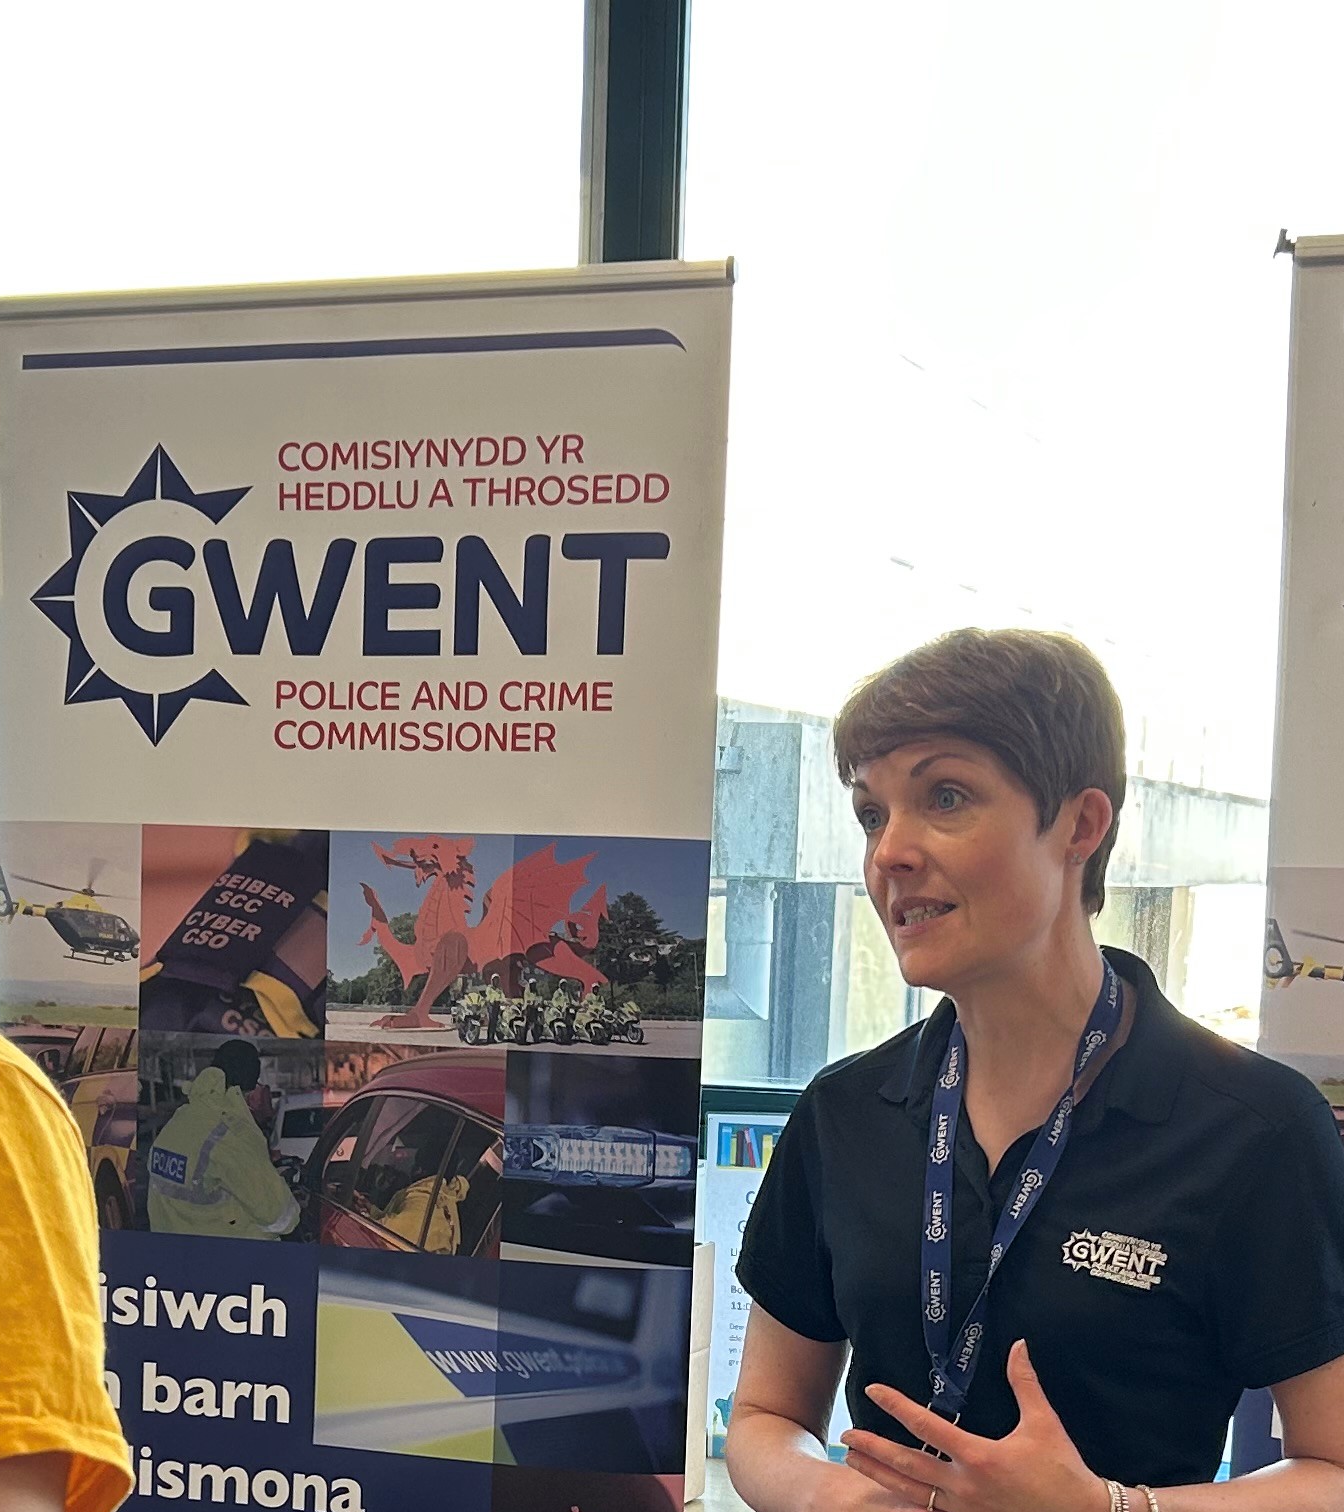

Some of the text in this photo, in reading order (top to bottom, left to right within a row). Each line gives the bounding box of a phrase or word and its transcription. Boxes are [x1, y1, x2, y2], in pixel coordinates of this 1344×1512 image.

[278, 434, 584, 472] COMISIYNYDD YR
[278, 473, 670, 511] HEDDLU A THROSEDD
[102, 532, 670, 658] GWENT
[275, 680, 614, 712] POLICE AND CRIME
[274, 722, 556, 752] COMMISSIONER
[214, 873, 295, 908] SEIBER
[215, 891, 263, 913] SCC
[182, 928, 229, 949] CSO
[186, 911, 261, 941] CYBER
[934, 1113, 949, 1160] GWENT
[1008, 1170, 1040, 1219] GWENT
[929, 1191, 944, 1238] GWENT
[1072, 1241, 1165, 1275] GWENT
[929, 1269, 943, 1317] GWENT
[957, 1327, 980, 1372] GWENT
[143, 1362, 290, 1423] barn
